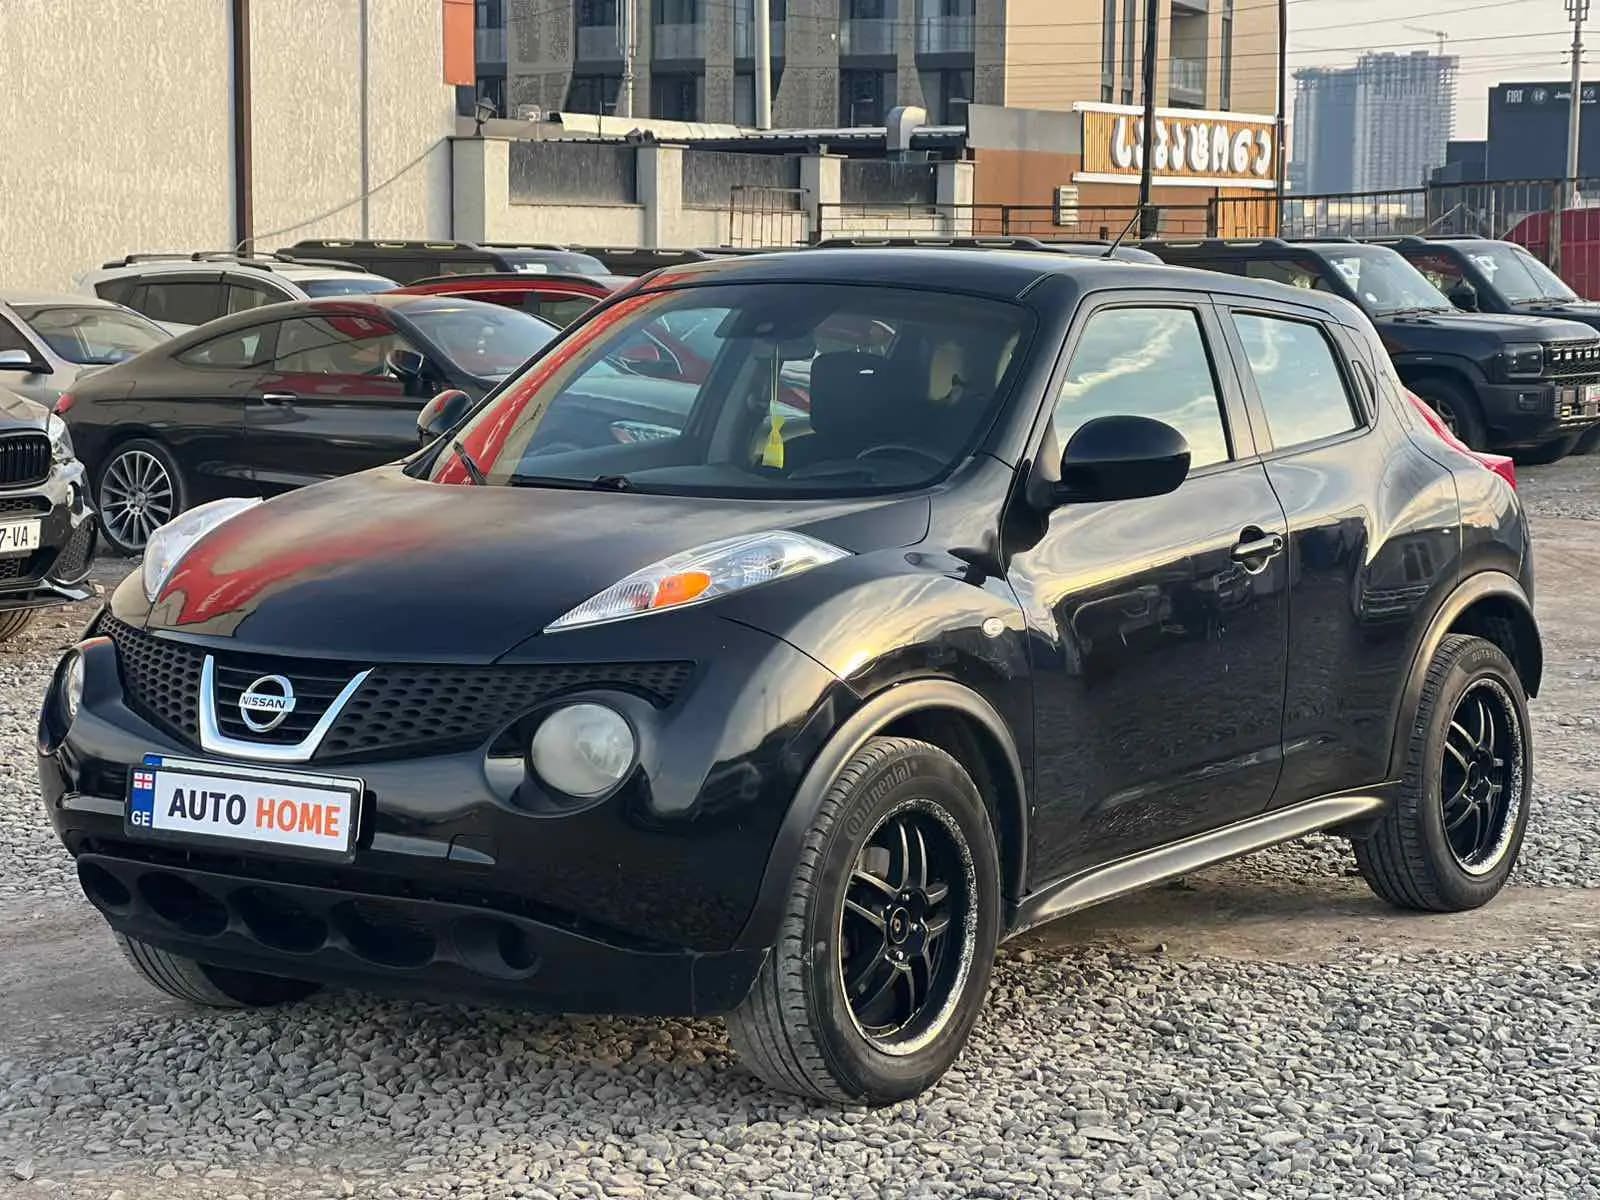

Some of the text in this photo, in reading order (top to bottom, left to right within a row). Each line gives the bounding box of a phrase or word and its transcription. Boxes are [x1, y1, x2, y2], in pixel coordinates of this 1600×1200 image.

[1506, 89, 1524, 104] FIAT
[240, 695, 287, 709] NISSAN
[131, 810, 151, 827] GE
[167, 787, 342, 838] AUTO HOME
